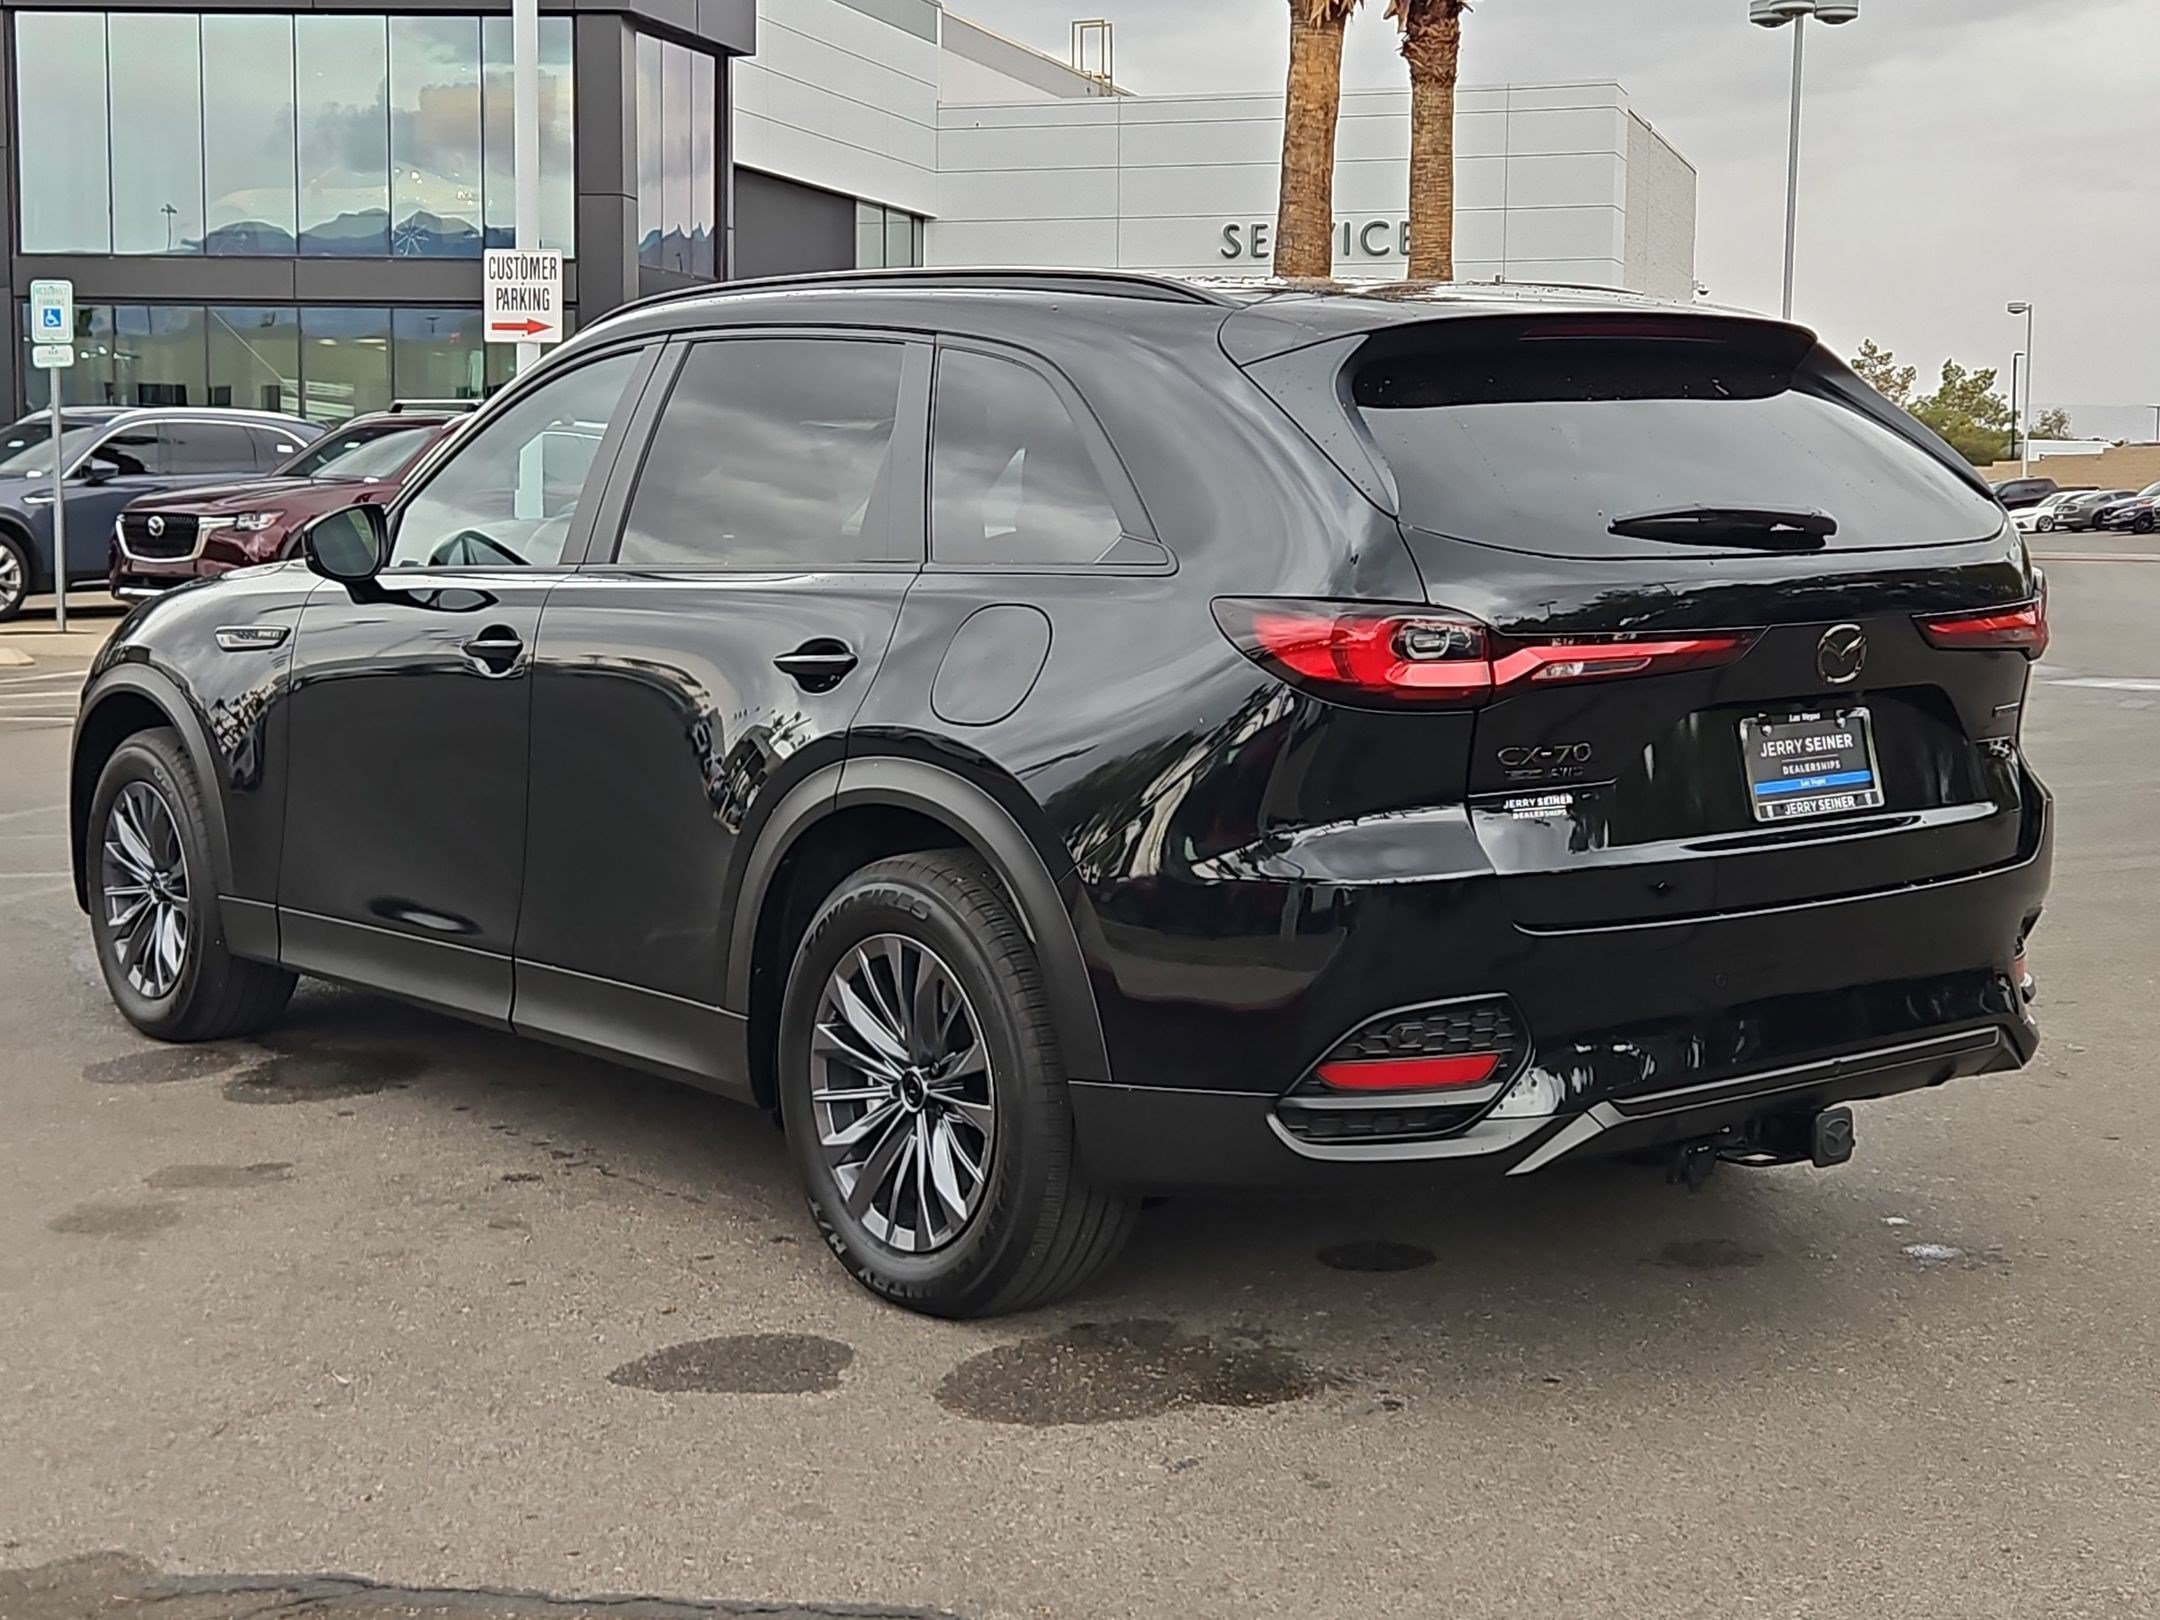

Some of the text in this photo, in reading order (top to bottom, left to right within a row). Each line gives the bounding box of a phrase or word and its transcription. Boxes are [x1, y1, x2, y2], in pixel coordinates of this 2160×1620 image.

[1220, 220, 1411, 258] SEICE
[489, 255, 557, 280] CUSTOMER
[496, 287, 550, 311] PARKING
[1497, 742, 1592, 765] CX-70
[1760, 733, 1853, 757] JERRY SEINER
[1782, 760, 1841, 775] DEALERSHIPS
[1503, 793, 1573, 809] JERRY SEINER
[1785, 796, 1856, 815] JERRY SEINER
[1513, 809, 1567, 820] DEALERSHIPS
